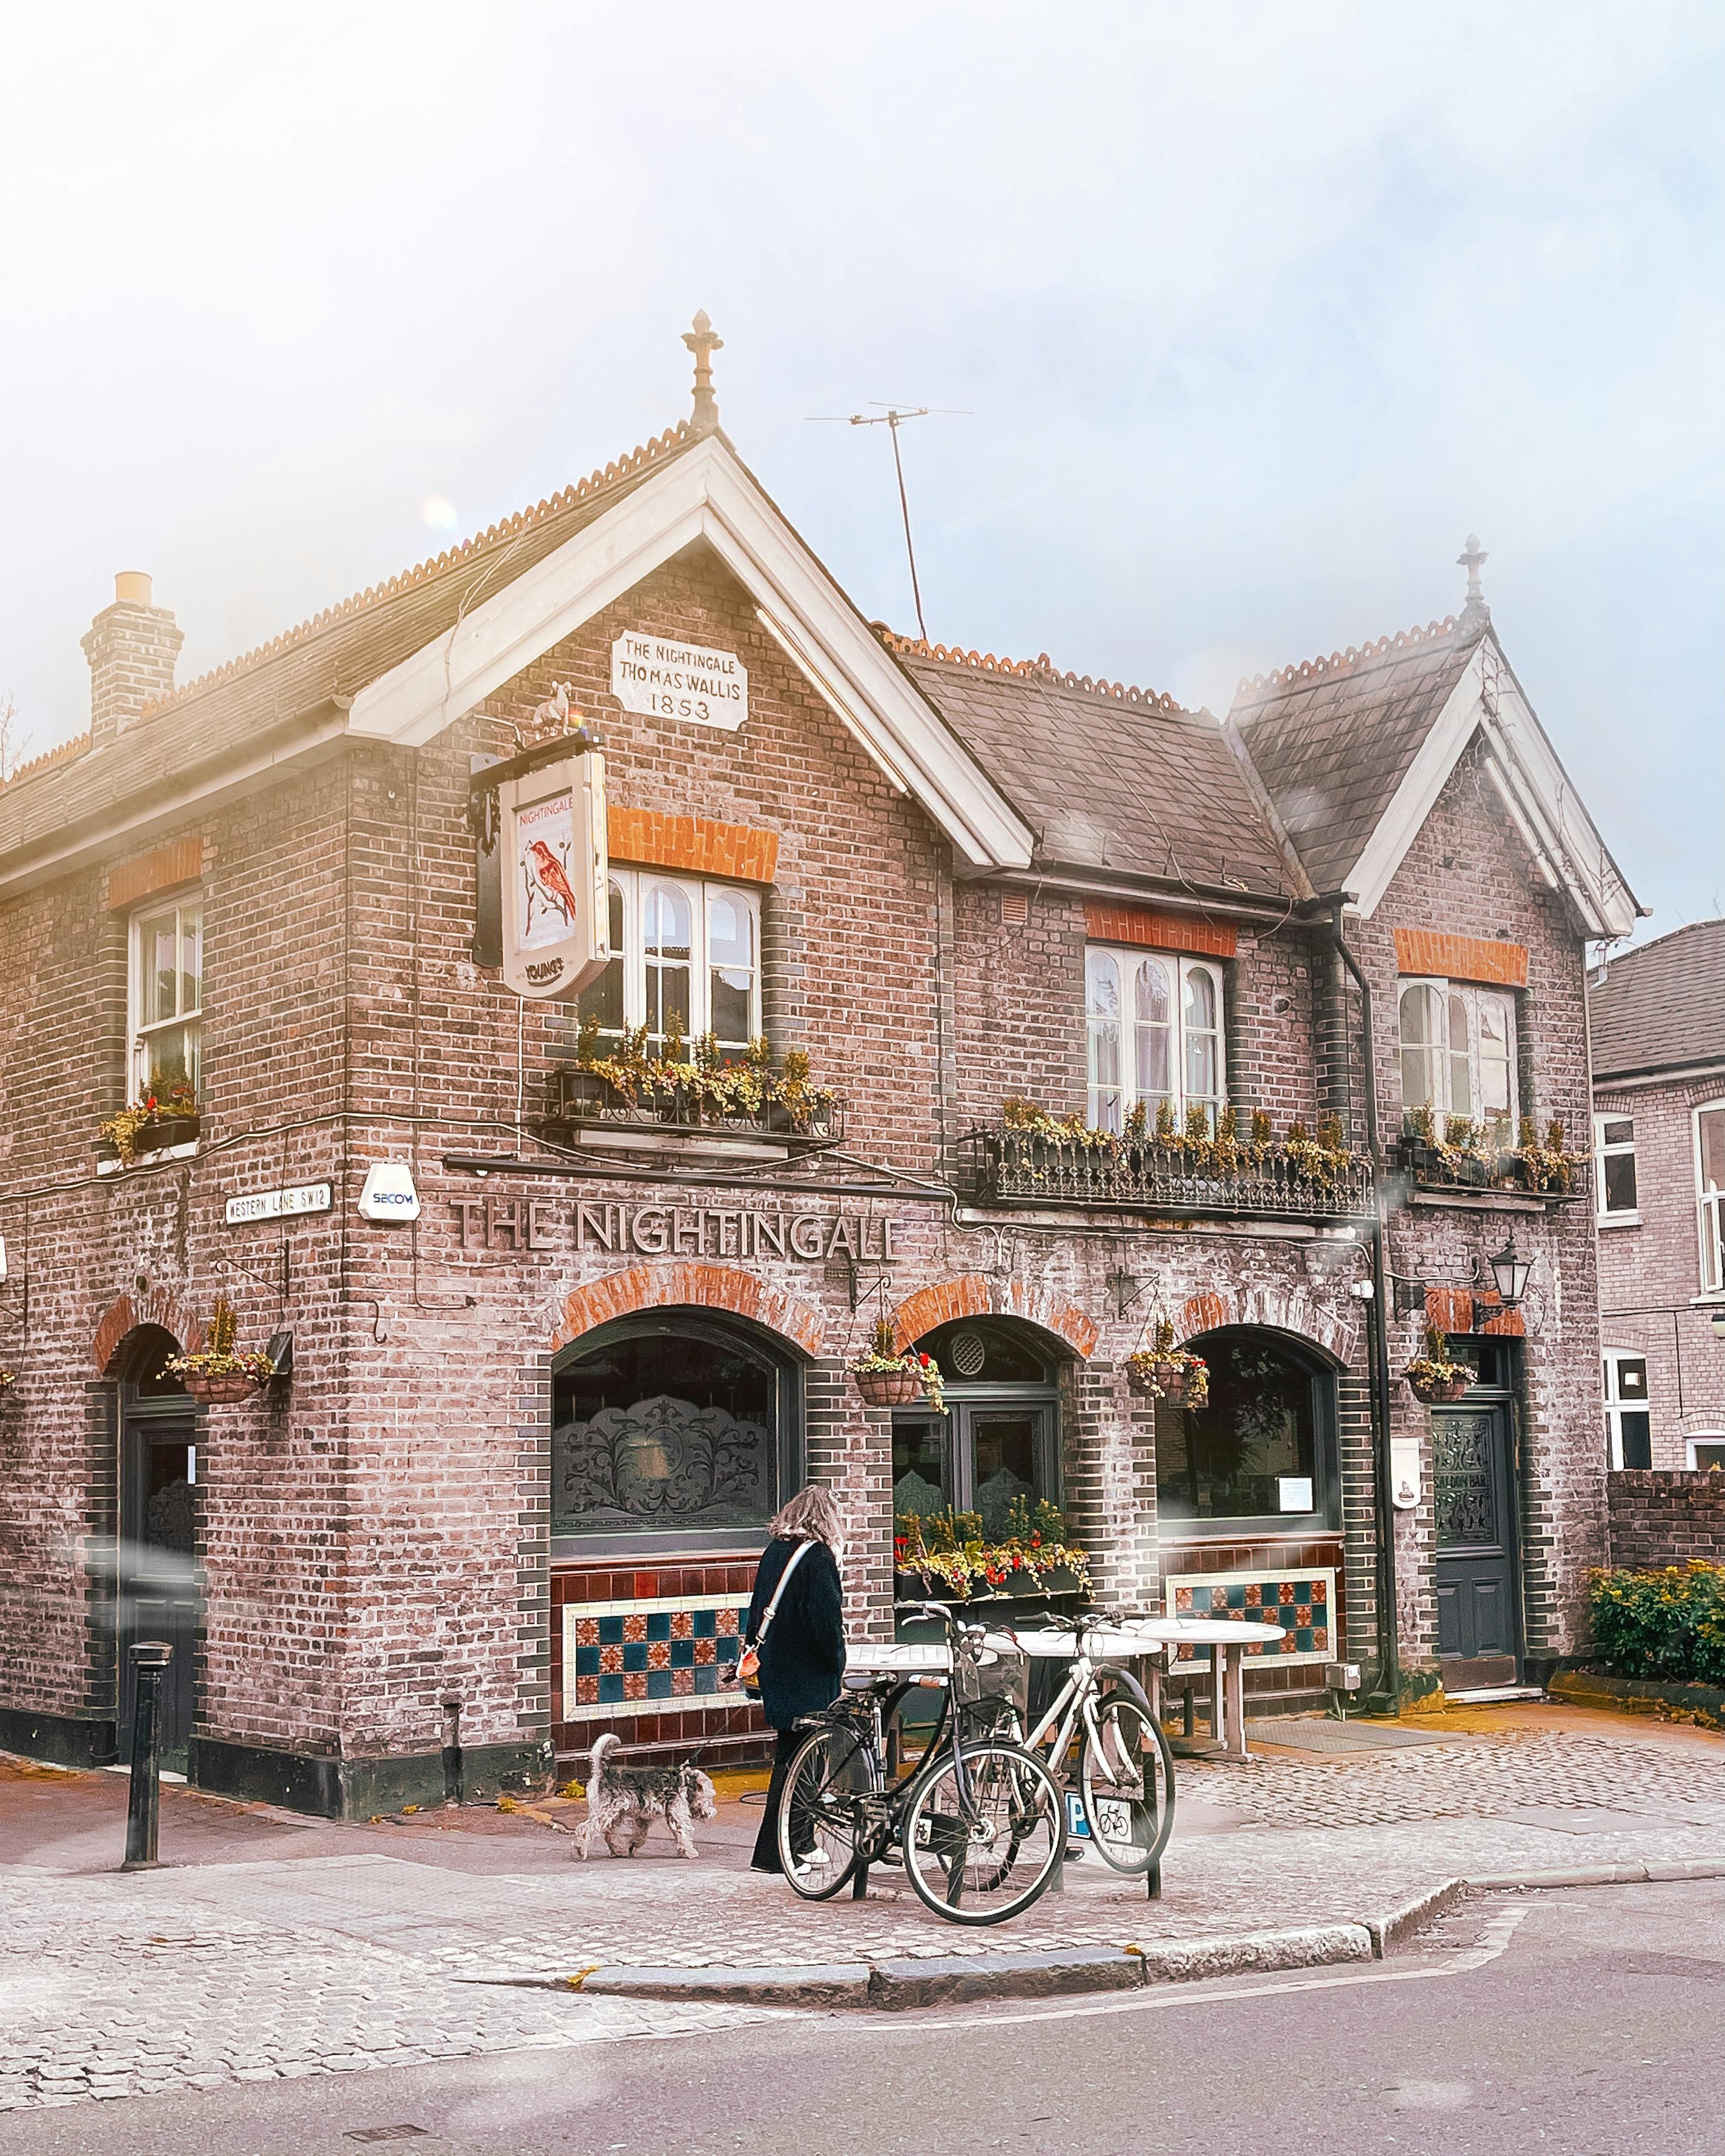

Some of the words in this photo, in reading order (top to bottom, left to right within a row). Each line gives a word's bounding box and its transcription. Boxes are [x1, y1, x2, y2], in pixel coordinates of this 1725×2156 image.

[626, 639, 650, 659] THE
[656, 645, 734, 674] NIGHTINGALE
[619, 661, 682, 689] THOMAS
[686, 673, 740, 700] WALLIS
[650, 693, 710, 720] 1853
[519, 797, 573, 827] NIGHTINGALE
[230, 1198, 266, 1217] WESTERN
[273, 1194, 294, 1211] LANE
[301, 1189, 324, 1208] SW12
[373, 1193, 413, 1205] SECOM
[450, 1199, 554, 1248] THE
[577, 1203, 906, 1260] NIGHTINGALE
[1069, 1797, 1086, 1834] P
